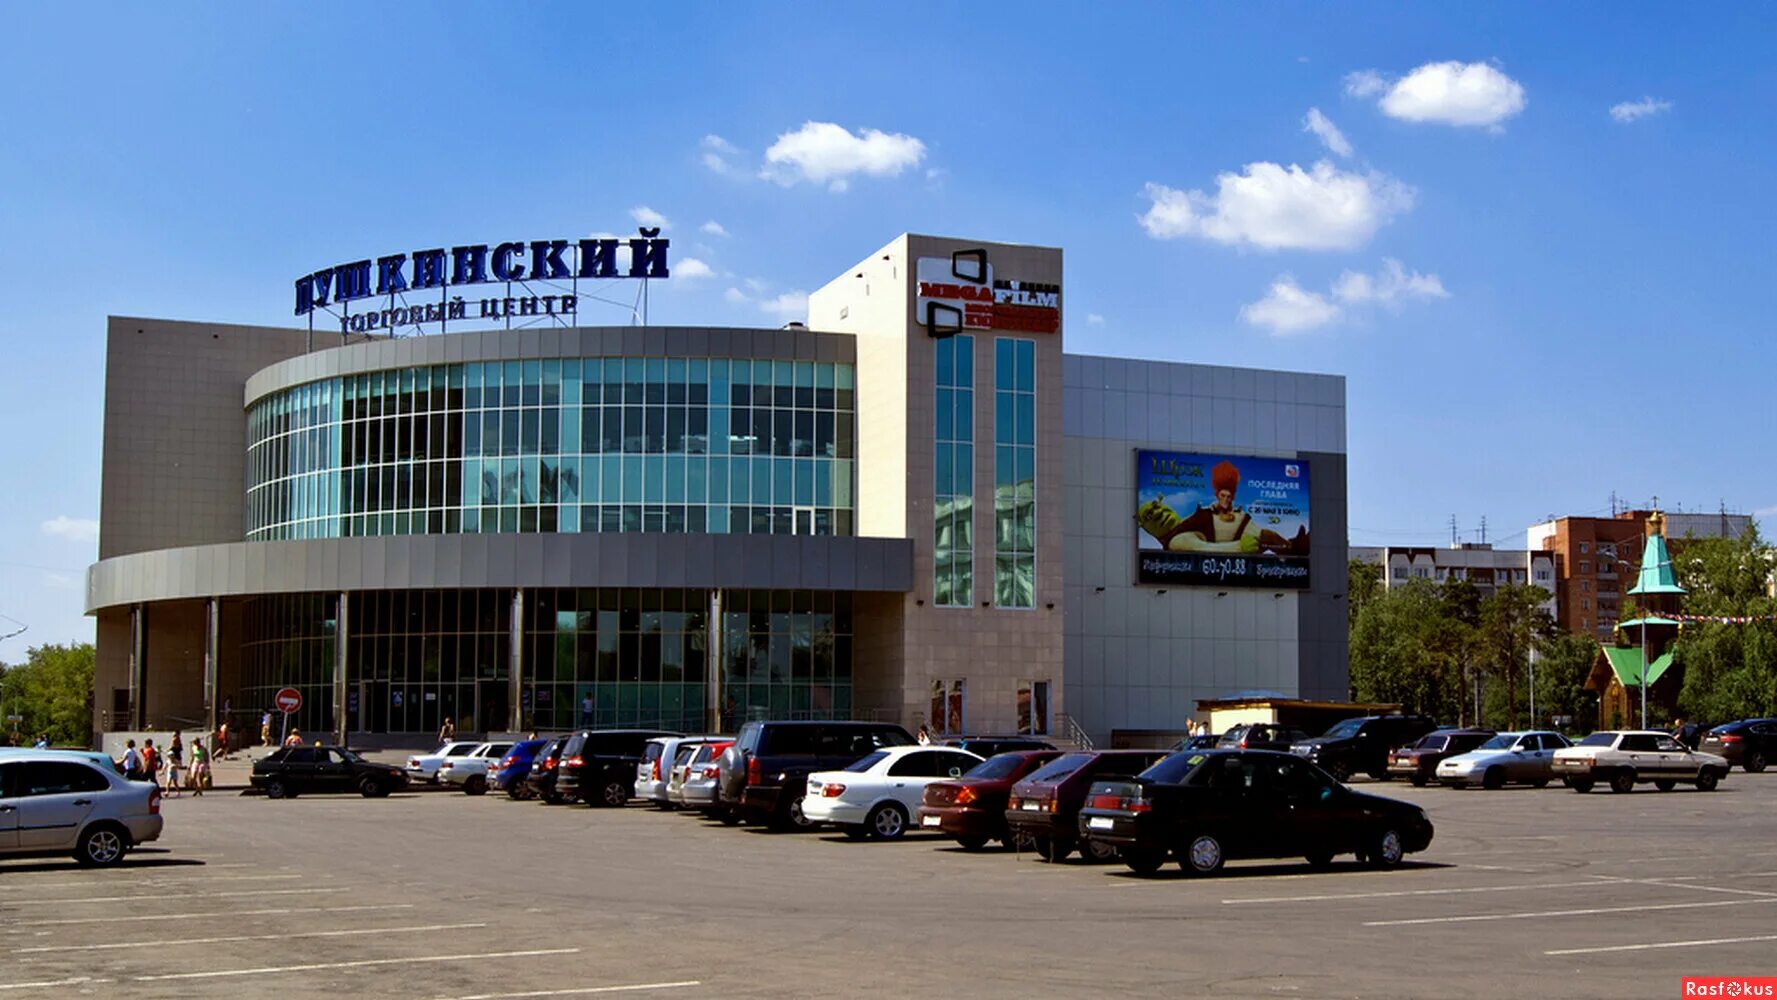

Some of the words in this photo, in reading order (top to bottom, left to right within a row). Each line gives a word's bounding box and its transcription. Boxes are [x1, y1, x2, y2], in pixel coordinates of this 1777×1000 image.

[294, 227, 670, 316] ПУШКИНСКИЙ
[340, 296, 466, 335] ТОРГОВЫЙ
[481, 295, 578, 321] ЦЕНТР
